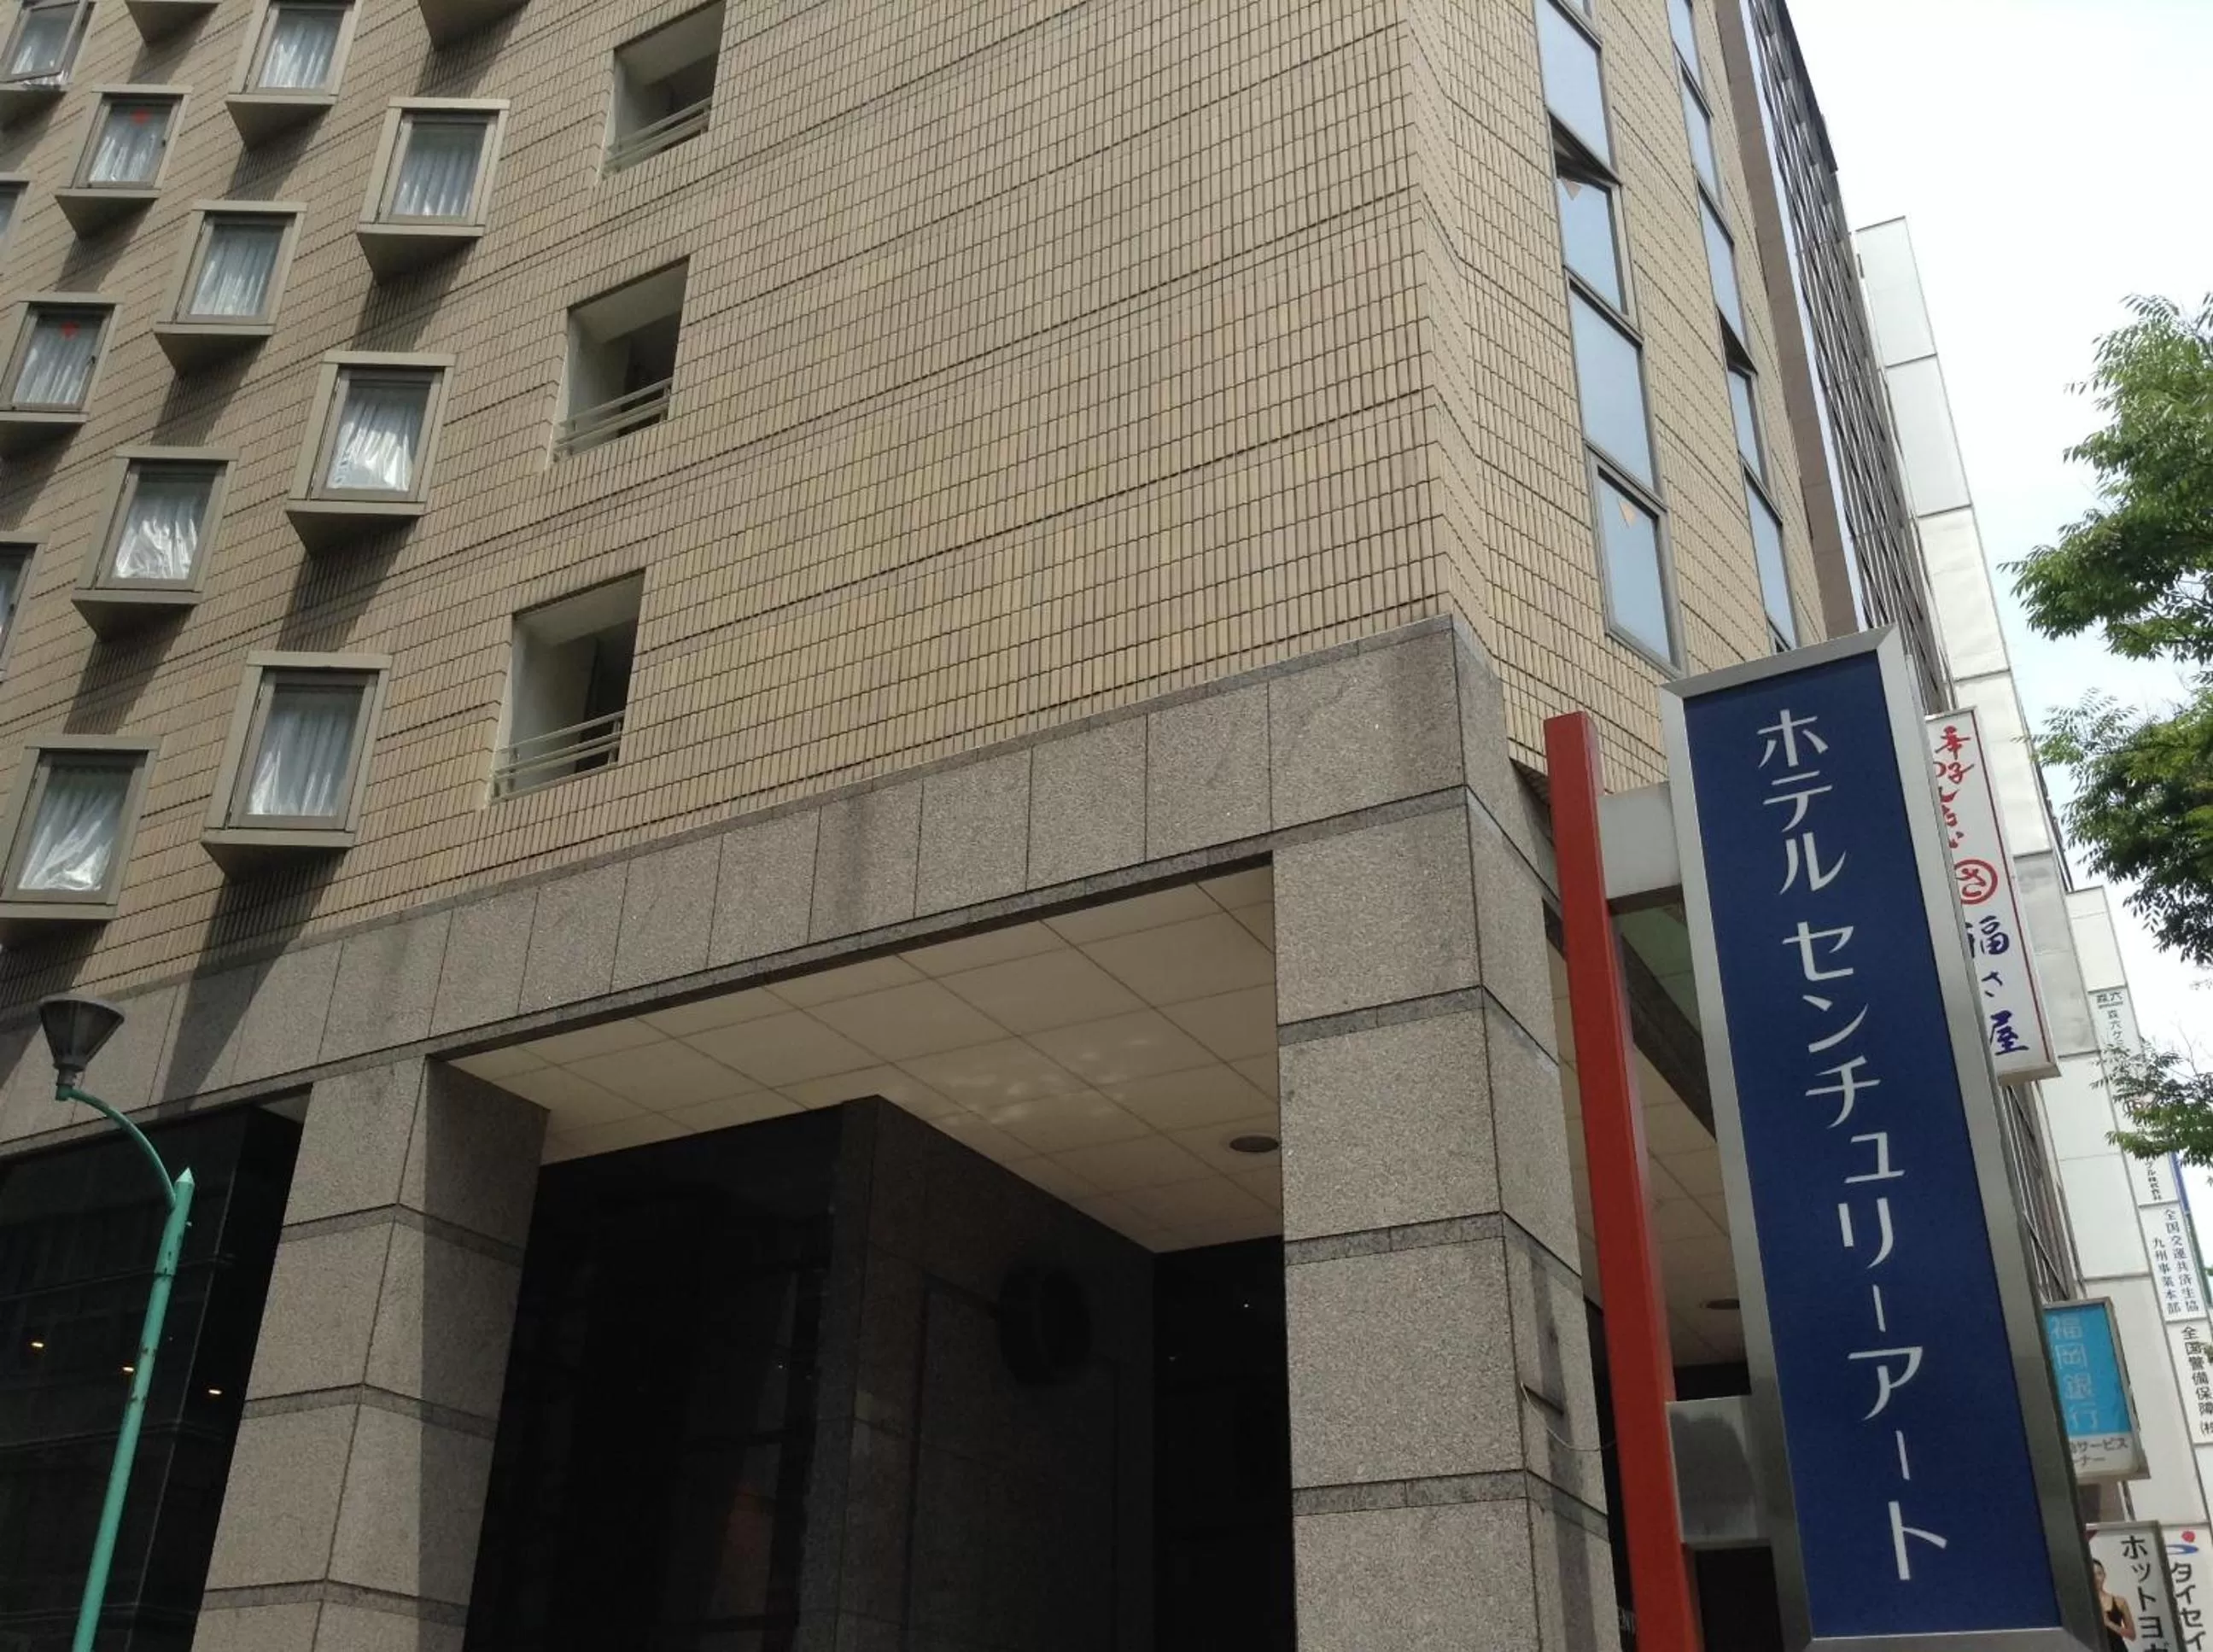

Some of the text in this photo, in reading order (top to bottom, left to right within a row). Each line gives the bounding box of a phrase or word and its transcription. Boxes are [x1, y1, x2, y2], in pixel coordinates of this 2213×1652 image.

[1757, 709, 1947, 1580] ホテルセンチュリーアート
[2050, 1313, 2099, 1430] 福岡銀行
